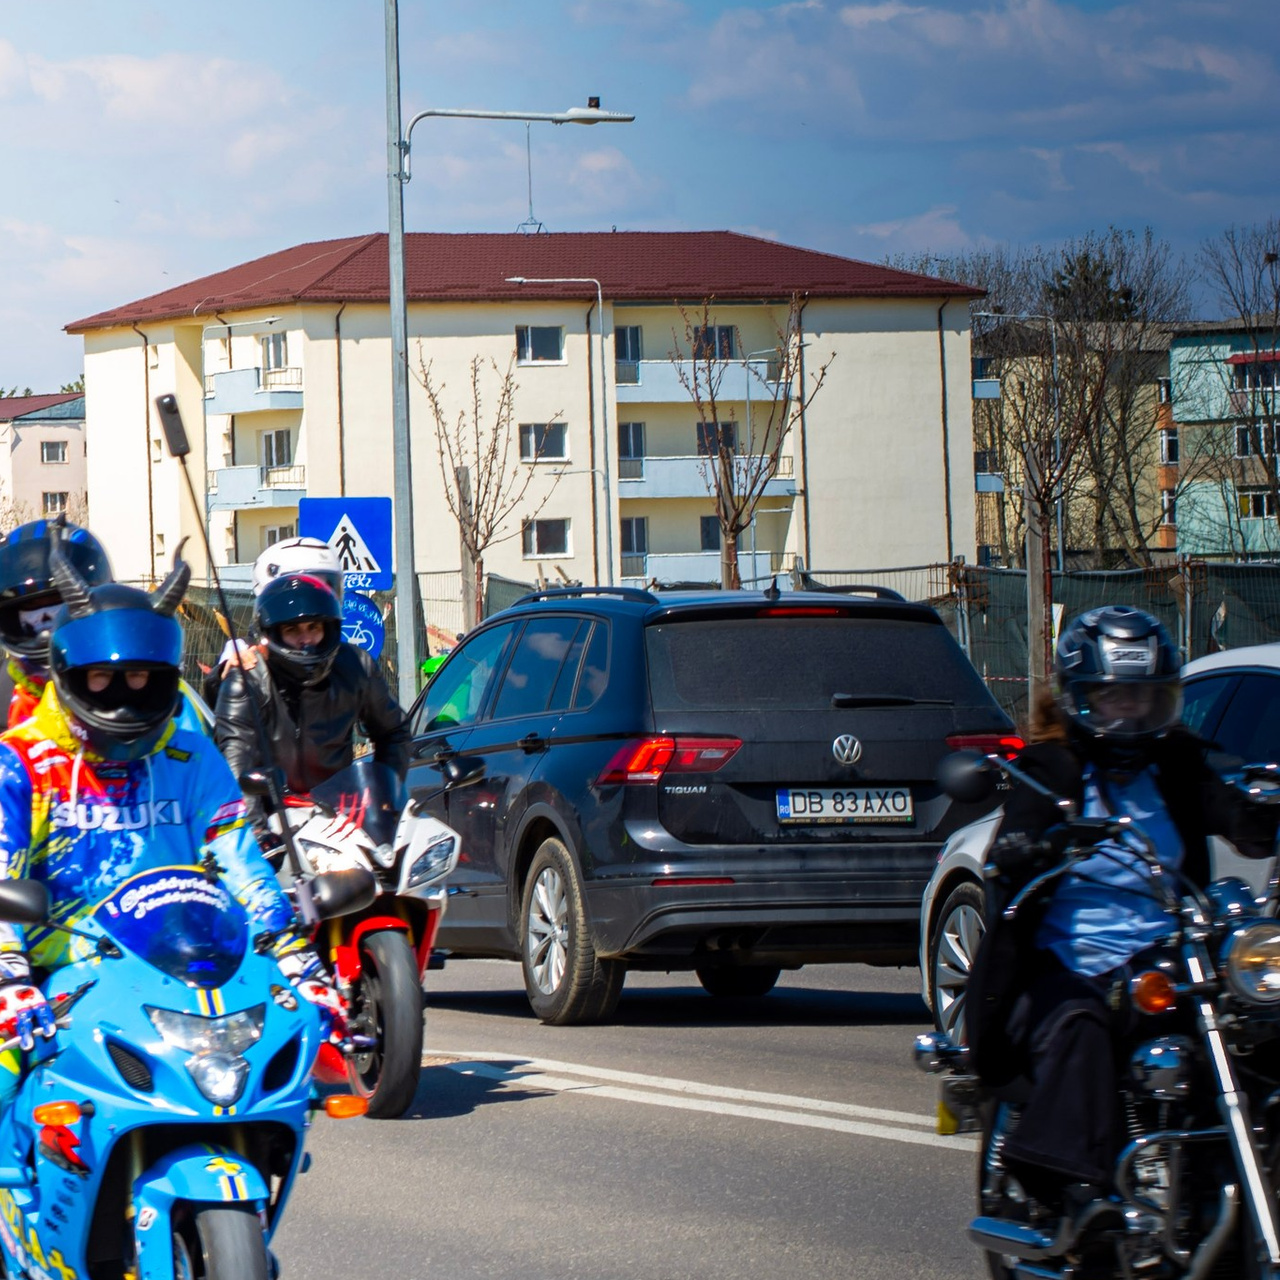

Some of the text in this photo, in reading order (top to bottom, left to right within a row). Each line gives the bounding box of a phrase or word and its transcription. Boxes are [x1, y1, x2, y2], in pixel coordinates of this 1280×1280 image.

[664, 786, 707, 794] TIGUAN
[779, 805, 790, 814] RO
[791, 790, 908, 814] DB 83 AXO
[53, 800, 182, 831] SUZUKI
